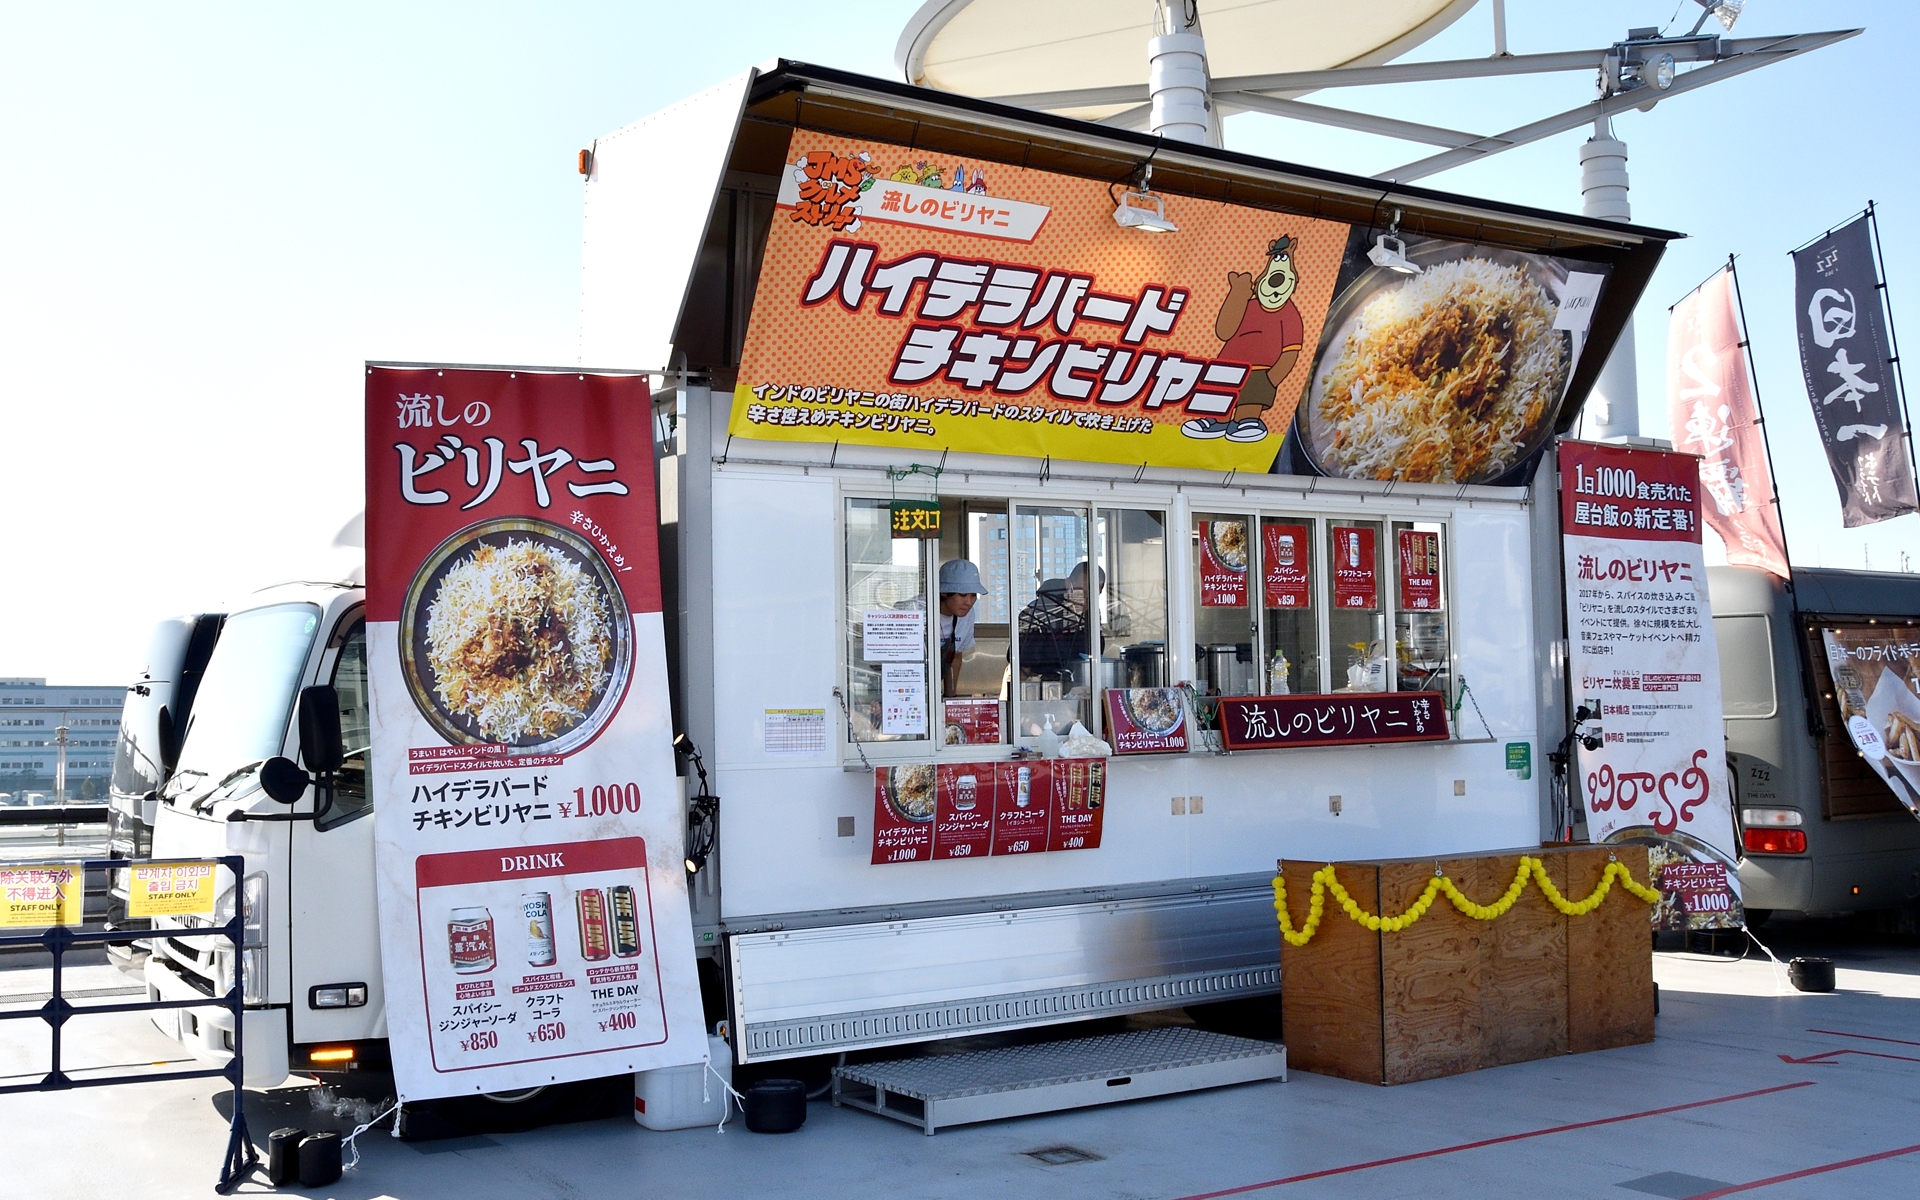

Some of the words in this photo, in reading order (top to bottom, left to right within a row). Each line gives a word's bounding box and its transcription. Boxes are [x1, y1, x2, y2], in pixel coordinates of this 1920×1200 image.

[804, 151, 867, 186] JMS
[798, 180, 862, 204] グルメ
[880, 190, 1011, 227] 流しのビリヤニ
[790, 201, 862, 231] ストリート
[804, 242, 1186, 344] ハイデラバード
[891, 326, 1250, 415] チキンビリヤニ
[396, 392, 491, 428] 流しの
[752, 383, 1154, 434] インドのビリヤニの街ハイデラバードのスタイルで炊き上げた
[747, 404, 936, 436] 辛さ控えめチキンビリヤニ。
[394, 435, 630, 510] ビリヤニ
[1575, 463, 1692, 502] 1日1000食売れた
[893, 508, 940, 531] 注文口
[1574, 502, 1695, 532] 屋台飯の新定番！
[569, 510, 632, 573] 辛さひかえめ！
[1274, 567, 1299, 575] スパイシー
[1338, 569, 1372, 578] クラフトコーラ
[1577, 554, 1693, 583] 流しのビリヤニ
[1267, 575, 1306, 583] ジンジャーソーダ
[1408, 578, 1421, 586] THE
[1421, 578, 1433, 586] DAY
[1204, 583, 1244, 591] チキンビリヤニ
[1277, 594, 1295, 605] ¥850
[1346, 595, 1363, 606] ¥650
[1578, 602, 1698, 615] 「ビリヤニ」を流しのスタイルでさまざまな
[1580, 617, 1702, 629] イベントにて提供。徐々に規模を拡大し、
[1581, 630, 1700, 643] 音楽フェスやマーケットイベントへ精力
[1603, 704, 1630, 715] 日本橋店
[1241, 702, 1409, 739] 流しのビリヤニ
[1118, 731, 1160, 740] ハイデラバード
[1119, 740, 1160, 749] チキンビリヤニ
[411, 775, 549, 803] ハイデラバード
[557, 782, 642, 819] ¥1,000
[412, 803, 552, 831] チキンビリヤニ
[948, 812, 981, 822] スパイシー
[1000, 809, 1045, 820] クラフトコーラ
[1061, 815, 1077, 823] THE
[1078, 813, 1093, 823] DAY
[878, 825, 928, 838] ハイデラバード
[938, 820, 990, 832] ジンジャーソーダ
[877, 836, 928, 848] チキンビリヤニ
[1007, 840, 1029, 852] ¥650
[1063, 836, 1084, 848] ¥400
[887, 848, 916, 861] ¥1,000
[949, 844, 971, 857] ¥850
[500, 853, 565, 873] DRINK
[1664, 864, 1723, 876] ハイデラバード
[0, 868, 73, 885] 除关联方外
[137, 867, 172, 879] 관계자
[176, 865, 211, 878] 이외의
[148, 880, 171, 892] 출입
[175, 879, 198, 891] 금지
[1664, 878, 1726, 889] チキンビリヤニ
[7, 886, 66, 901] 不得进入
[10, 904, 37, 912] STAFF
[38, 903, 62, 911] ONLY
[583, 894, 602, 920] THE
[614, 892, 632, 918] THE
[1684, 893, 1729, 912] ¥1,000
[525, 909, 548, 919] COLA
[587, 923, 605, 951] DAY
[618, 921, 636, 947] DAY
[591, 988, 614, 999] THE
[617, 985, 639, 997] DAY
[526, 994, 564, 1008] クラフト
[452, 1003, 502, 1017] スパイシー
[532, 1008, 561, 1020] コーラ
[438, 1012, 517, 1032] ジンジャーソーダ
[598, 1011, 636, 1032] ¥400
[527, 1021, 566, 1043] ¥650
[460, 1030, 498, 1051] ¥850
